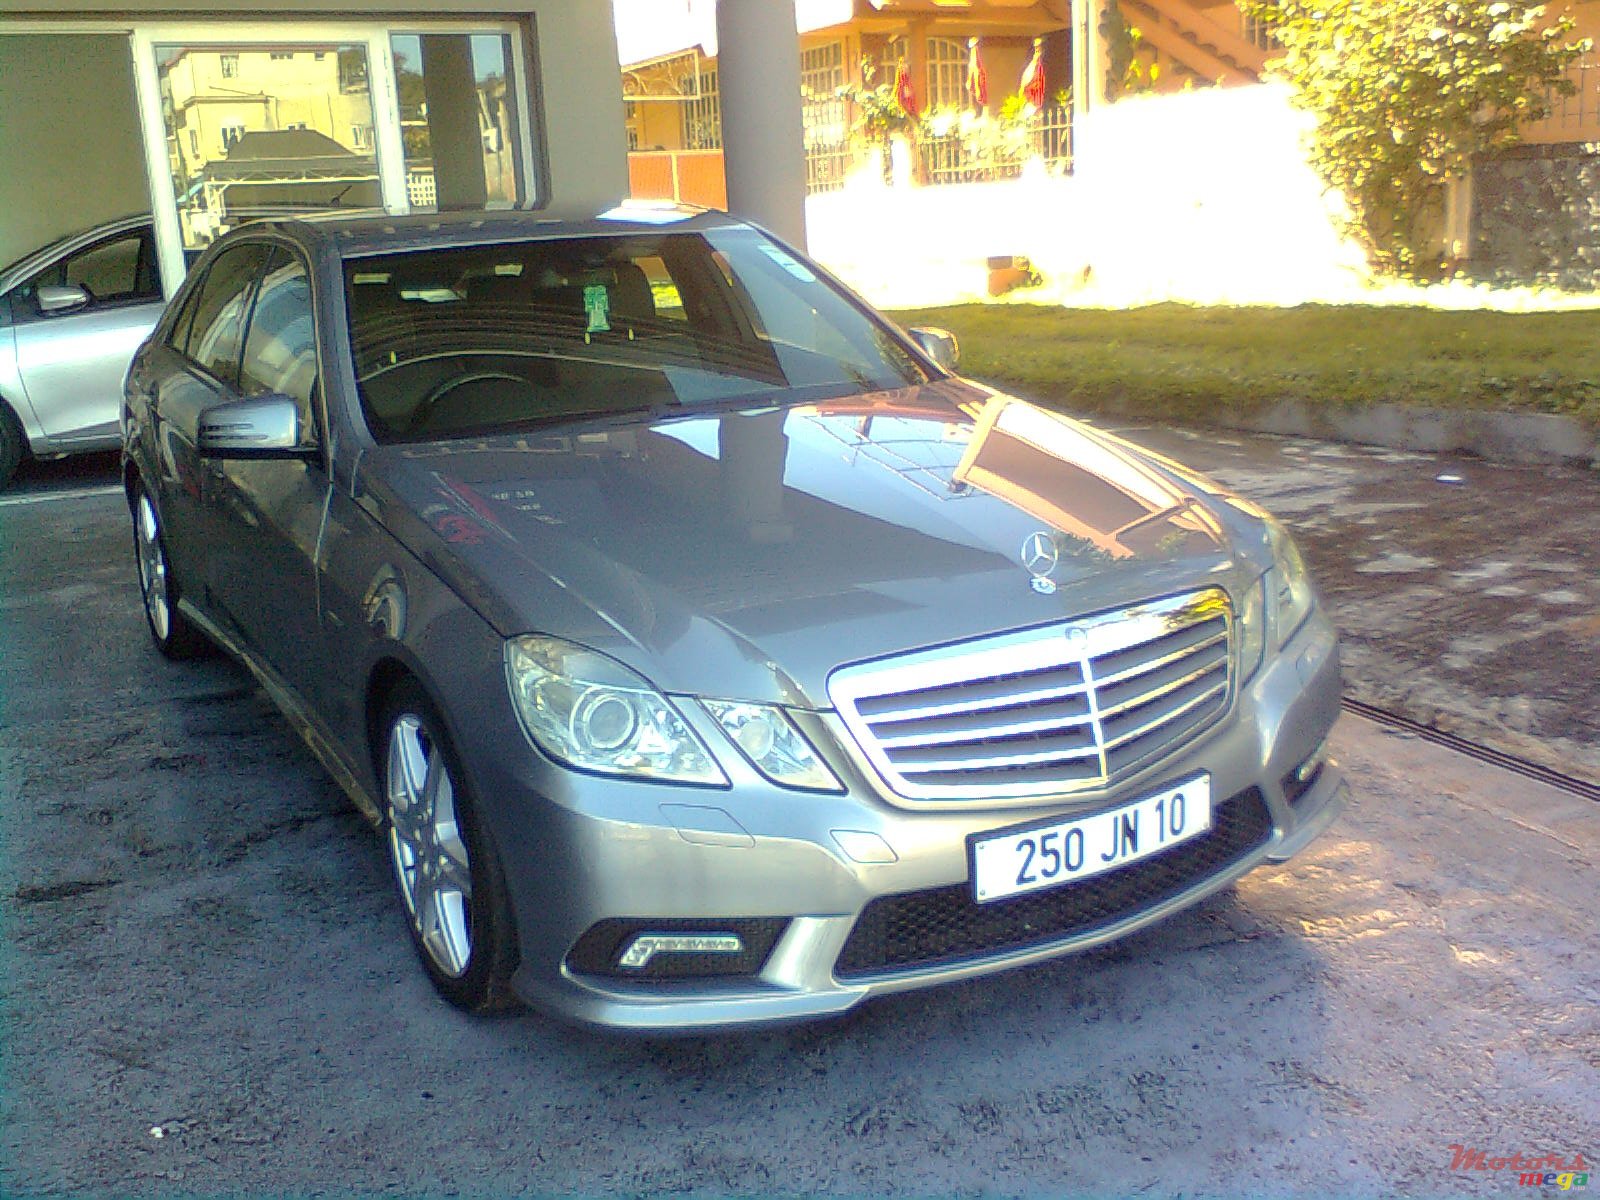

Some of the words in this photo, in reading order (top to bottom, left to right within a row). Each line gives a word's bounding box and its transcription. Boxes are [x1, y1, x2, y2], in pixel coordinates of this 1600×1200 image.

[1016, 828, 1084, 885] 250
[1102, 809, 1139, 862] JN
[1155, 793, 1185, 843] 10
